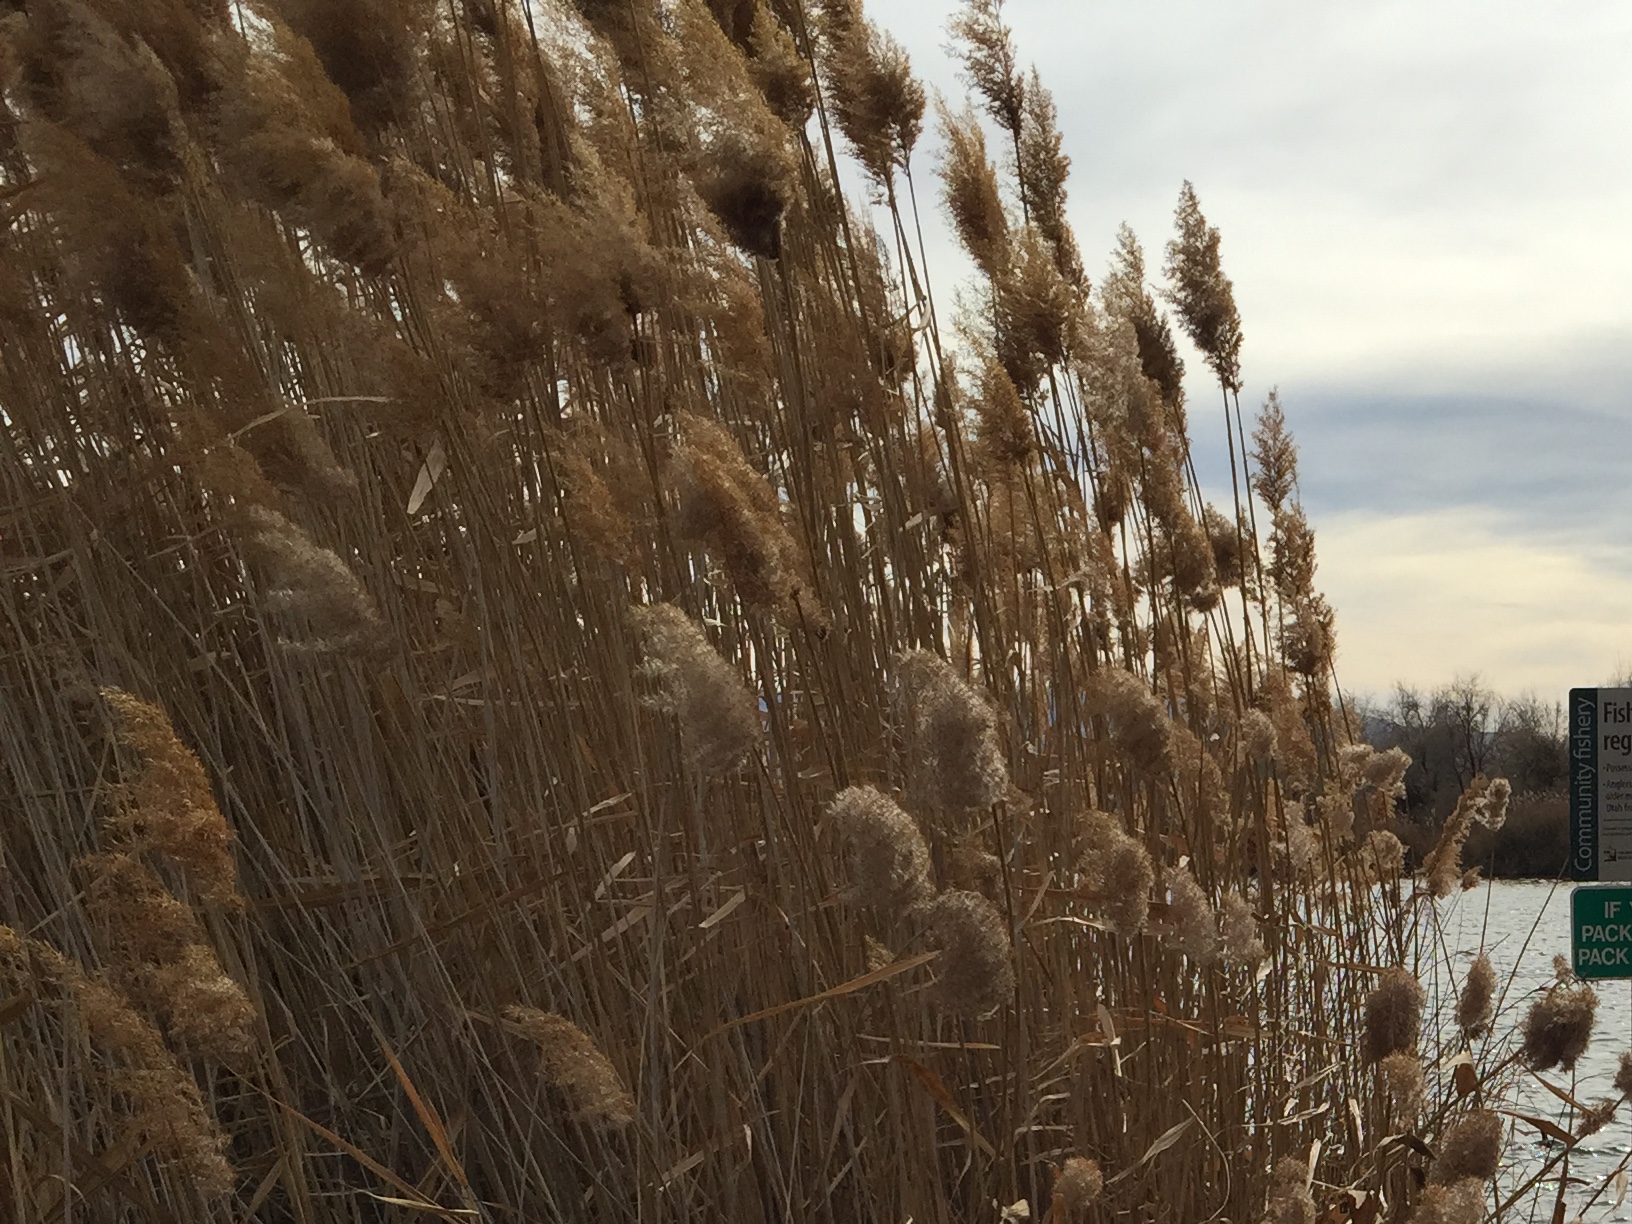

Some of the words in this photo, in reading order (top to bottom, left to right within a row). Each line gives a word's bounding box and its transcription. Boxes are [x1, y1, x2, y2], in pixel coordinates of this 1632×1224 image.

[1573, 698, 1595, 759] fishery
[1574, 762, 1595, 872] Community
[1604, 901, 1622, 919] IF
[1581, 924, 1632, 942] PACK
[1578, 947, 1630, 966] PACK
